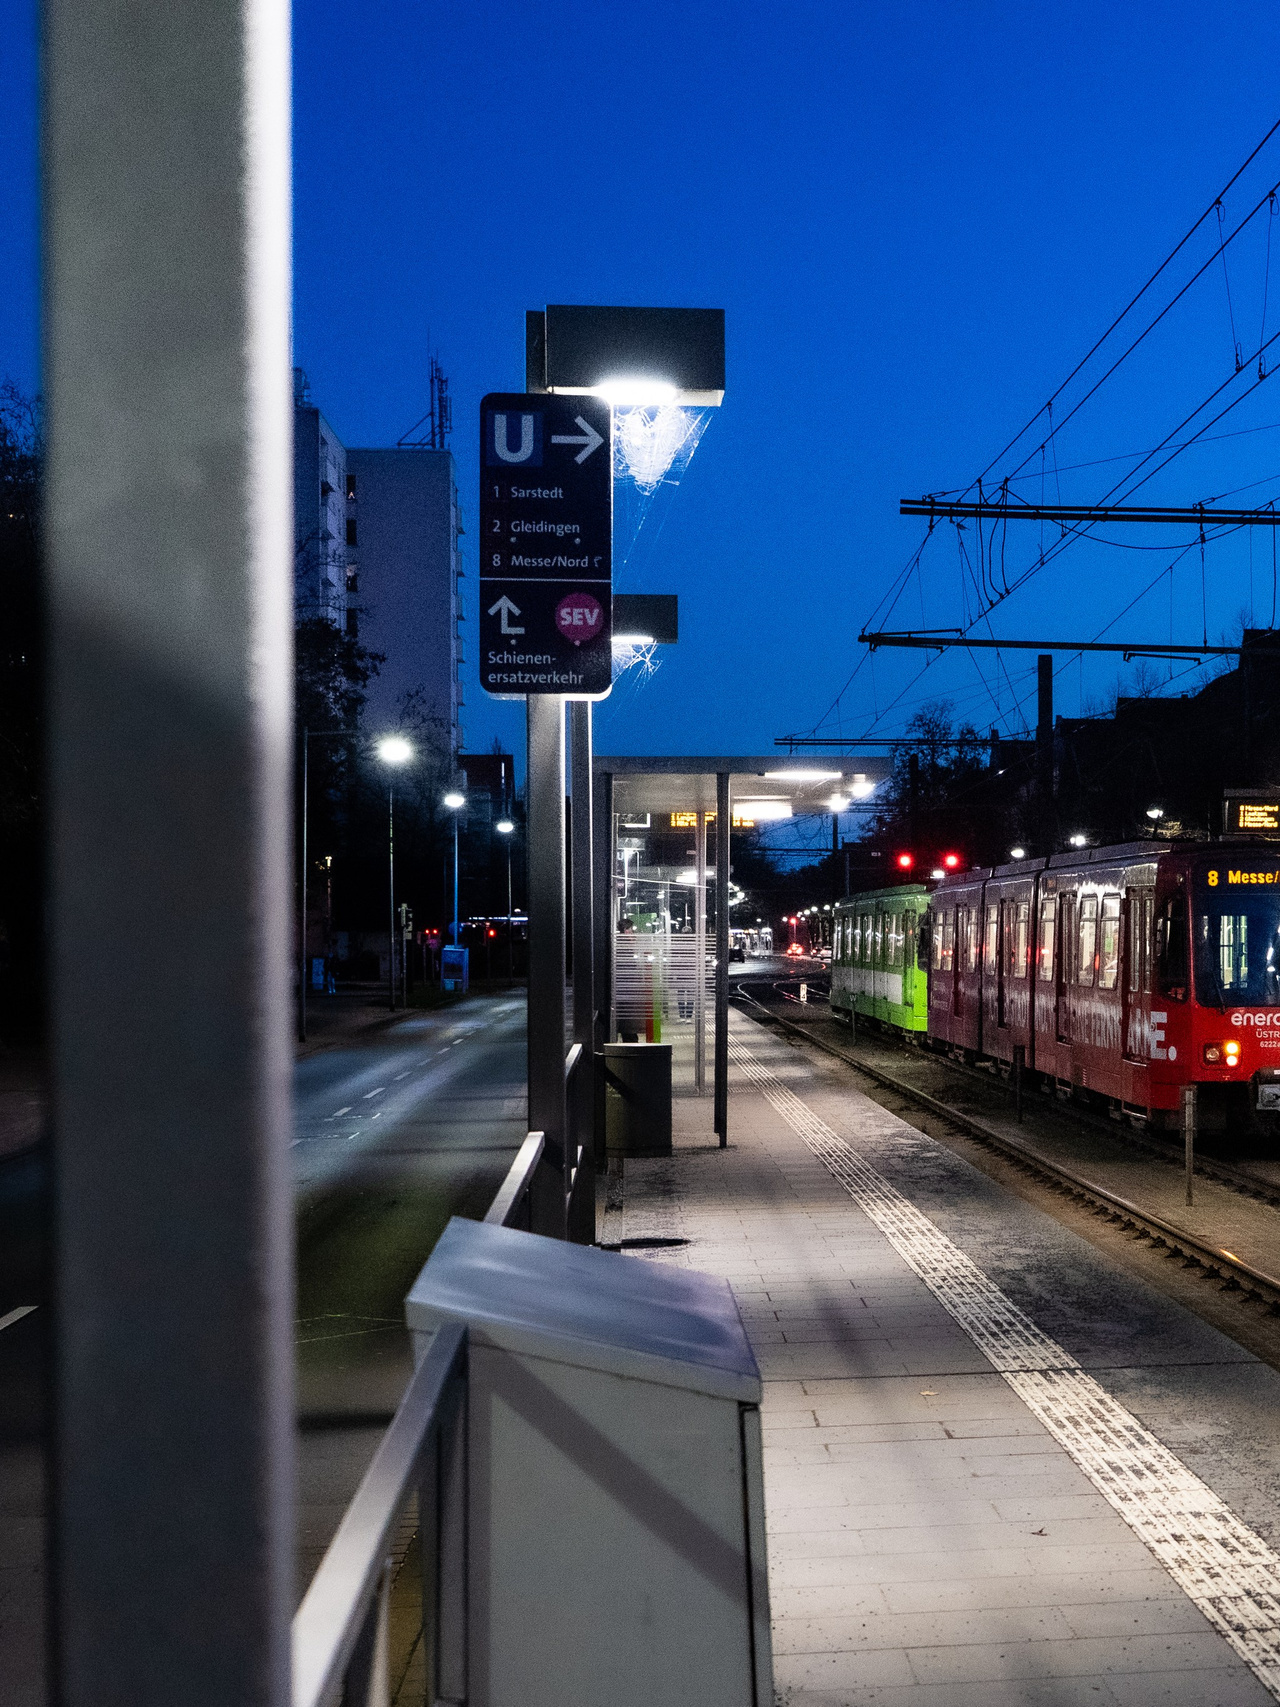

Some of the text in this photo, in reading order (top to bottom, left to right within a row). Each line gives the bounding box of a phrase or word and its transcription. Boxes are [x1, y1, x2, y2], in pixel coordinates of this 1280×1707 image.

[494, 414, 534, 463] U
[493, 485, 564, 499] 1 Sarstedt
[492, 519, 580, 536] 2 Gleidingen
[492, 553, 589, 568] 8 Messe/Nord
[560, 607, 599, 626] SEV
[487, 651, 557, 665] Schienen-
[487, 670, 584, 684] ersatzverkehr
[1207, 870, 1219, 886] 8
